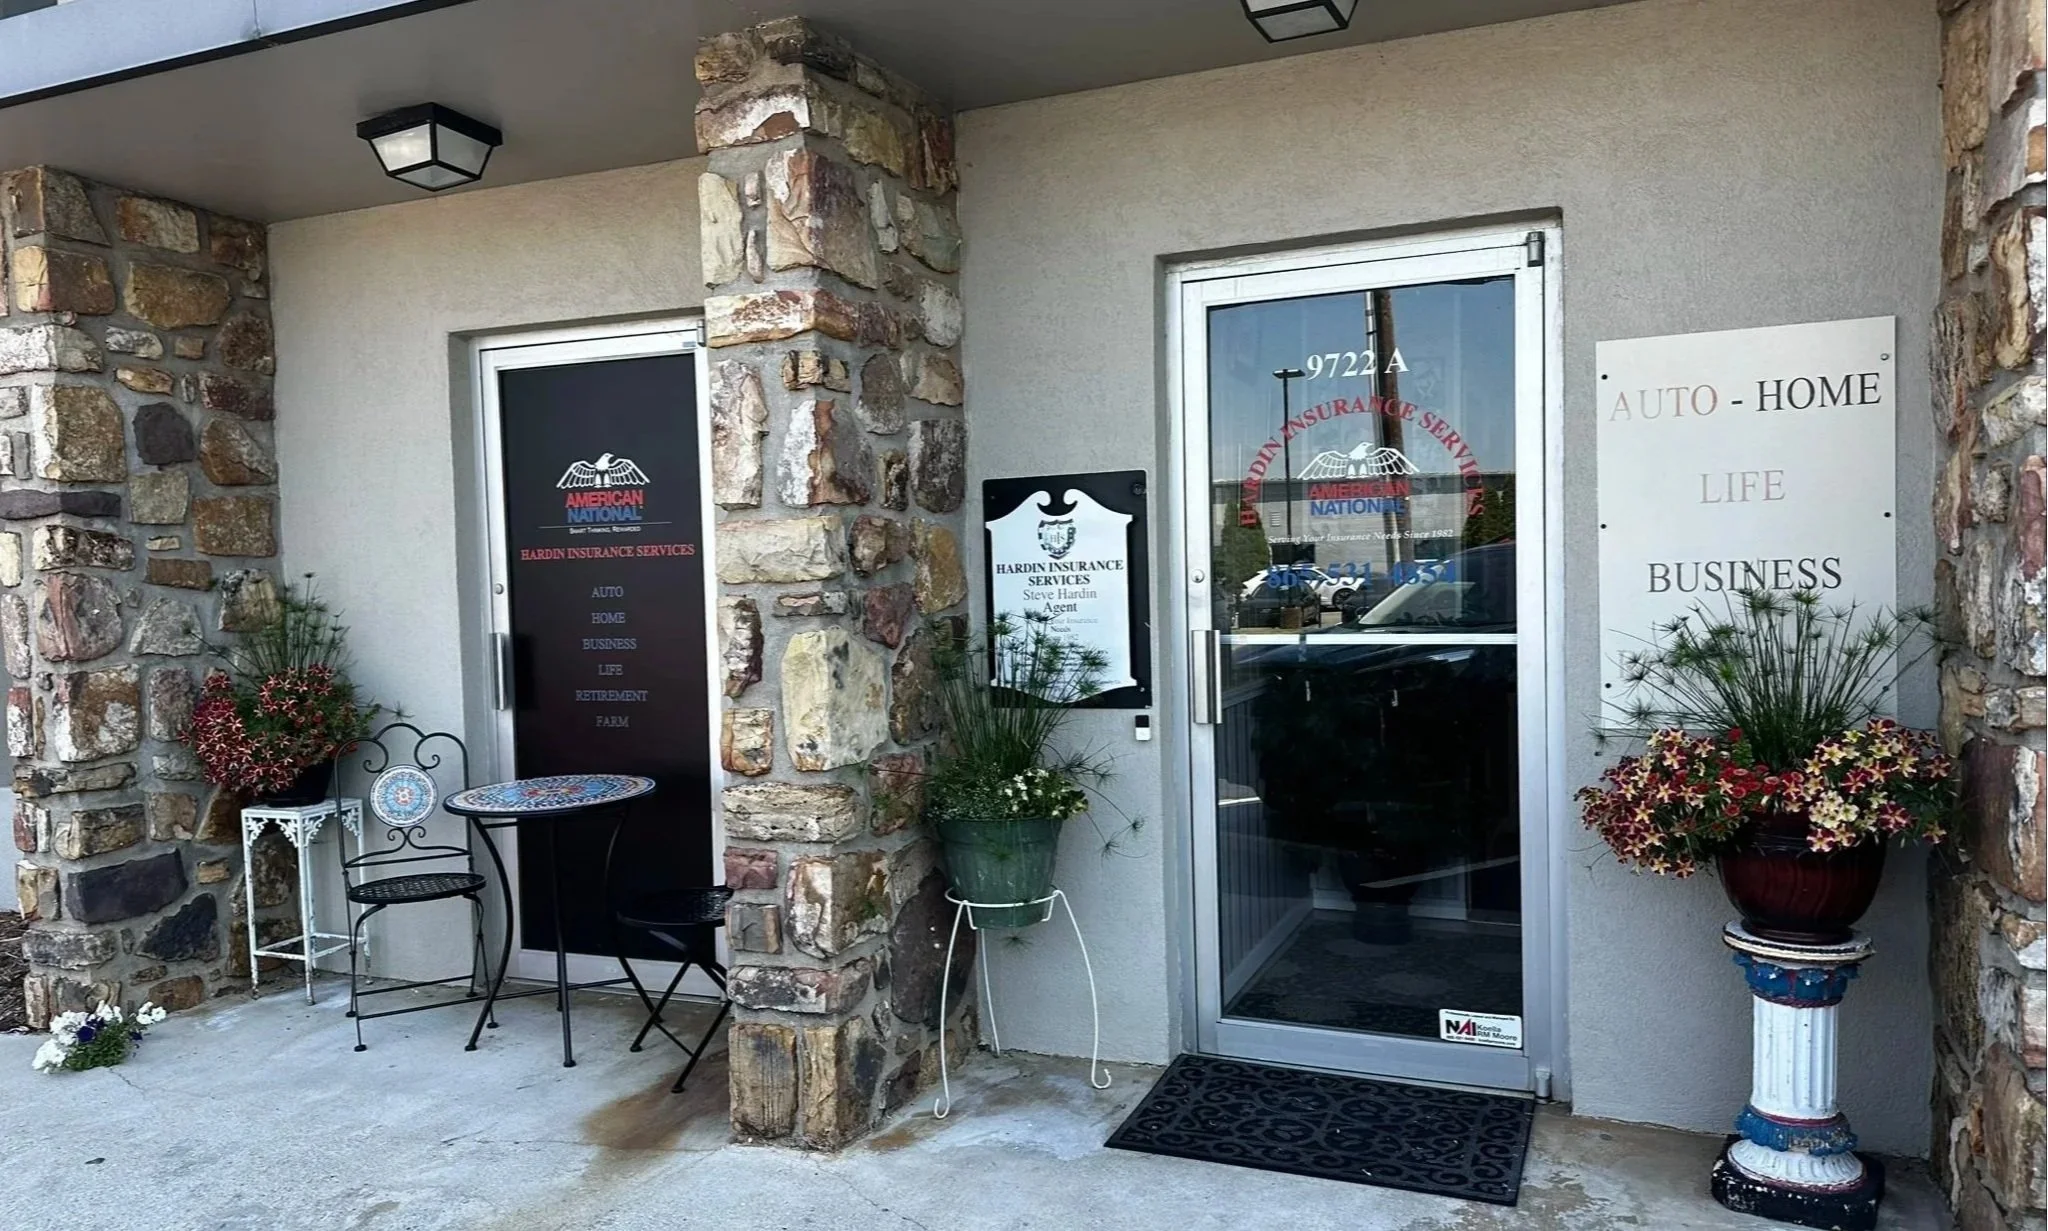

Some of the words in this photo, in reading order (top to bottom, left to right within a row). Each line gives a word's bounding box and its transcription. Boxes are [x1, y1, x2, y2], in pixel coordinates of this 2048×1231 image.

[1306, 350, 1377, 380] 9722
[1384, 347, 1410, 373] A
[1609, 384, 1718, 421] AUTO
[1755, 372, 1882, 411] HOME
[1240, 436, 1283, 527] HARDIN
[1280, 396, 1418, 440] INSURANCE
[1418, 412, 1486, 517] SERVICES
[1309, 481, 1411, 500] AMERICAN
[1699, 469, 1786, 504] LIFE
[565, 490, 643, 508] AMERICAN
[567, 505, 643, 523] NATIONAL
[1310, 499, 1406, 516] NATIONAL
[1267, 534, 1300, 545] Serving
[1302, 534, 1324, 543] Your
[1326, 532, 1372, 542] Insurance
[1374, 531, 1401, 540] Needs
[1403, 529, 1430, 539] Since
[1431, 529, 1454, 538] 1982
[521, 548, 565, 561] HARDIN
[567, 546, 634, 559] INSURANCE
[637, 544, 695, 557] SERVICES
[996, 562, 1046, 575] HARDIN
[1049, 560, 1124, 573] INSURANCE
[1647, 557, 1843, 594] BUSINESS
[1028, 574, 1091, 586] SERVICES
[591, 587, 624, 598] AUTO
[1023, 590, 1054, 600] Steve
[1057, 588, 1098, 600] Hardin
[1043, 602, 1078, 615] Agent
[591, 612, 626, 624] HOME
[582, 638, 637, 650] BUSINESS
[598, 664, 623, 676] LIFE
[575, 690, 648, 702] RETIREMENT
[596, 716, 629, 728] FARM
[1445, 1019, 1476, 1036] NAI
